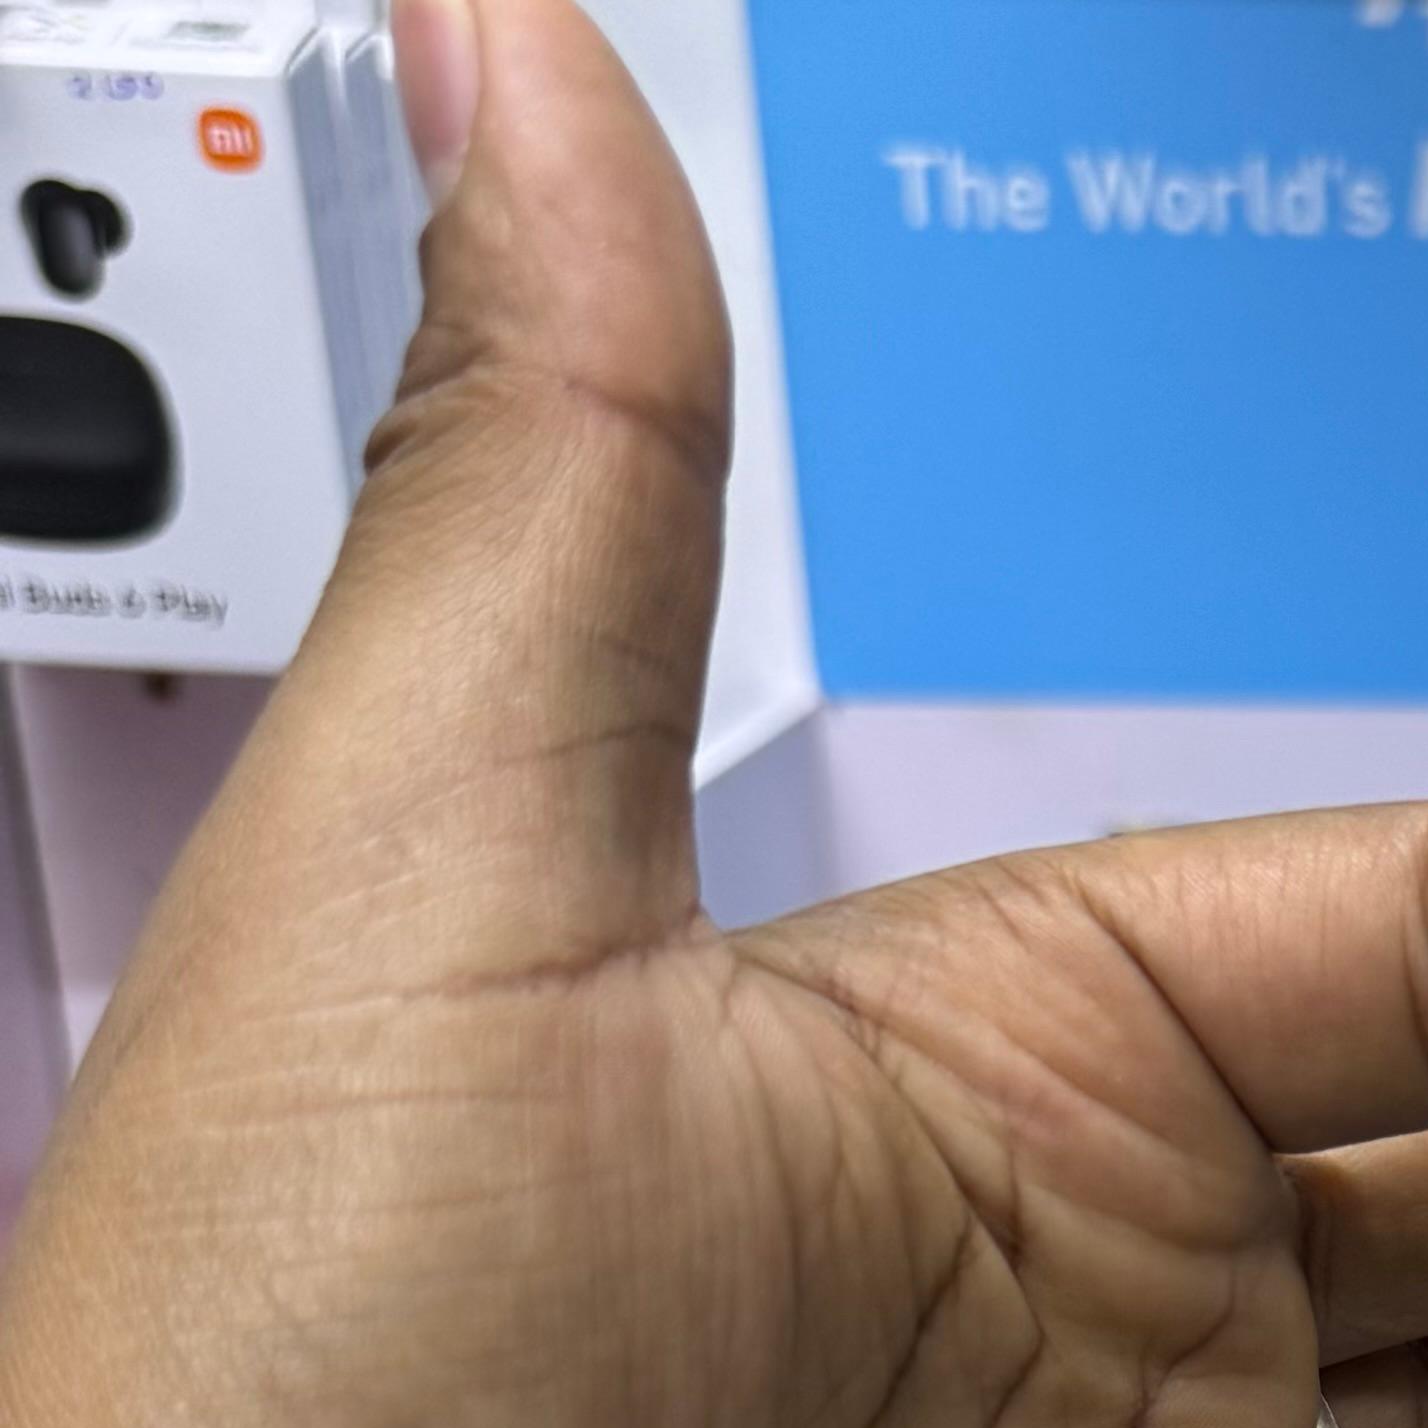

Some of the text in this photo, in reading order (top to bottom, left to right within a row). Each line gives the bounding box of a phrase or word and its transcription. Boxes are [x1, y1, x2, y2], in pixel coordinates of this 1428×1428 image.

[884, 145, 1051, 233] The
[1066, 145, 1392, 238] World's
[152, 579, 228, 631] Play
